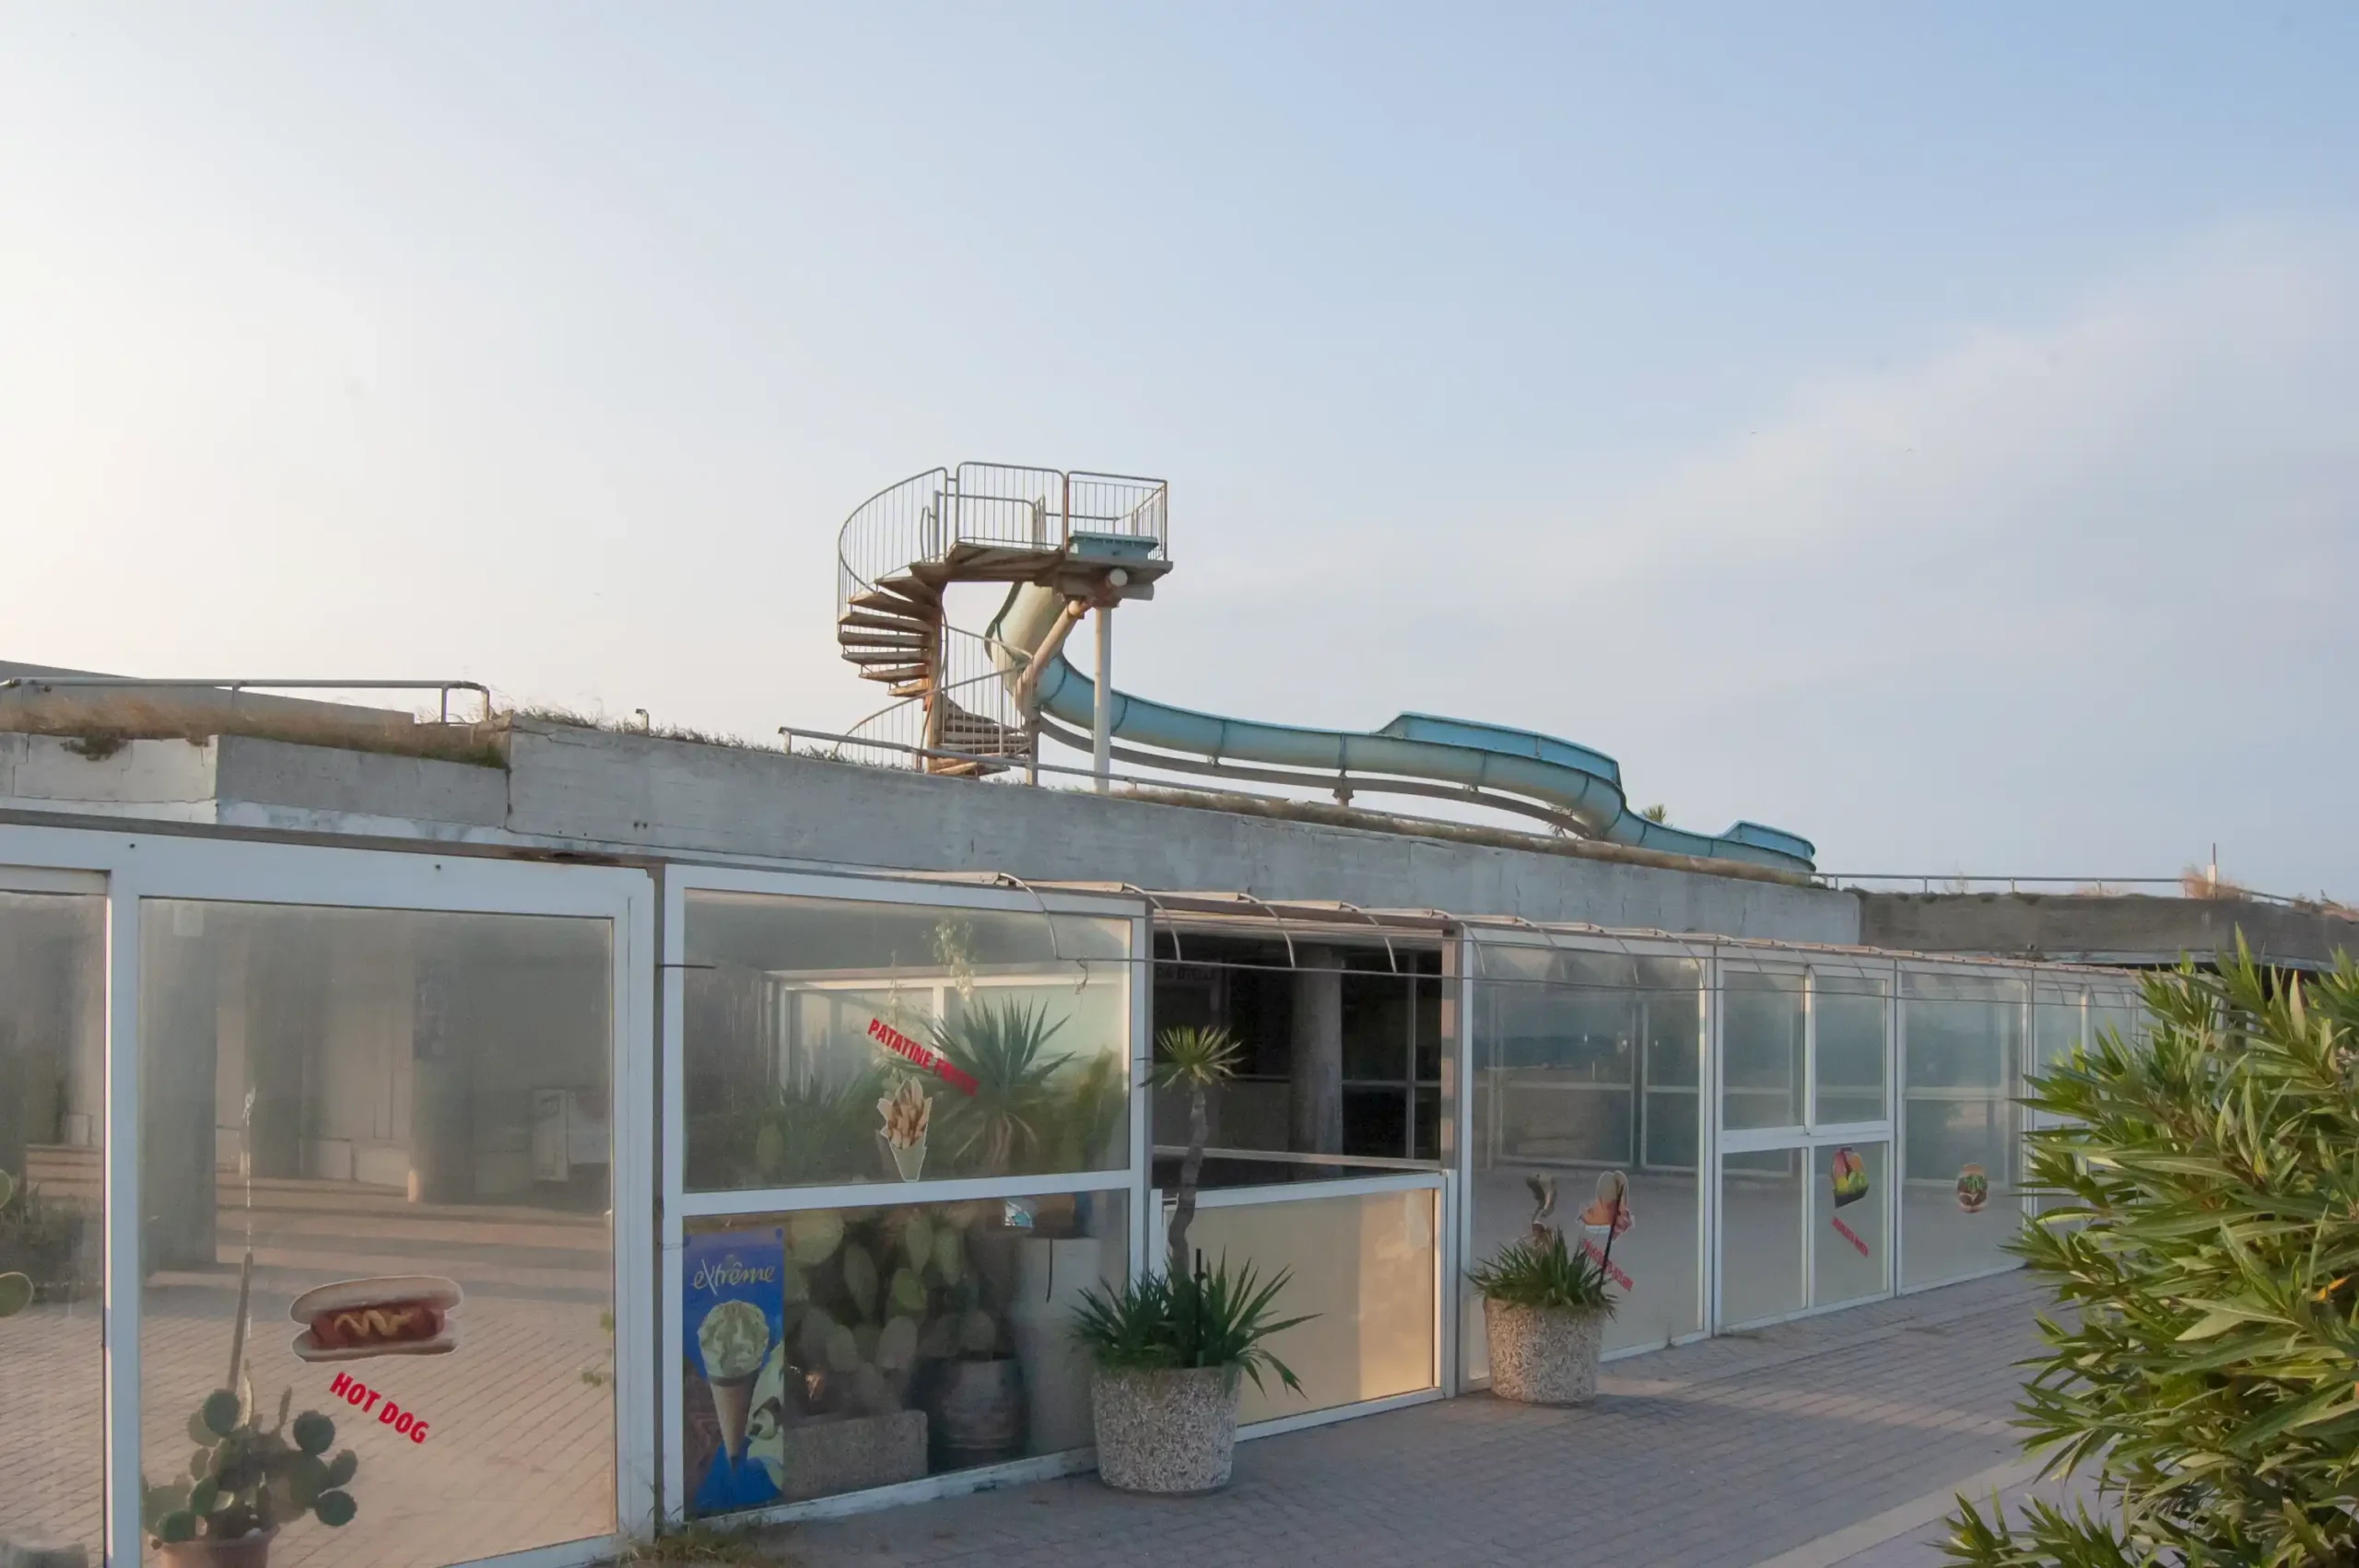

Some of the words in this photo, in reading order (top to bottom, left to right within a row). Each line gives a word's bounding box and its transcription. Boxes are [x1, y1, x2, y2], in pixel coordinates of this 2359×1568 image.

[867, 1017, 933, 1071] PATATINE
[329, 1371, 381, 1413] HOT
[378, 1399, 430, 1445] DOG
